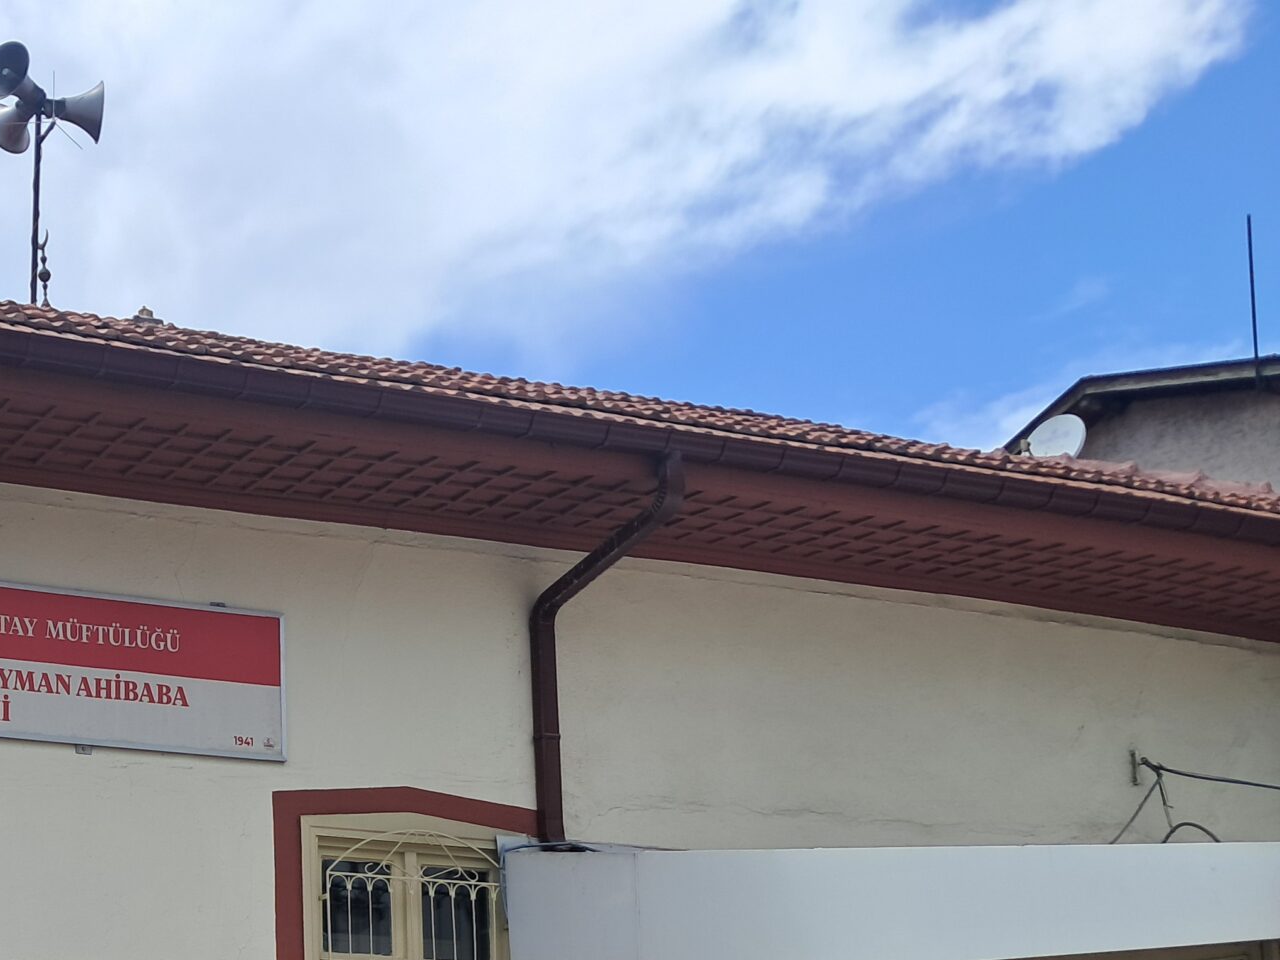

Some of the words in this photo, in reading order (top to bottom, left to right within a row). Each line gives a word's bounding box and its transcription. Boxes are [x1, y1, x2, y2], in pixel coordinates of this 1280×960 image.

[45, 617, 181, 653] MÜFTÜLÜĞÜ
[76, 673, 190, 708] AHİBABA
[233, 735, 255, 748] 1941
